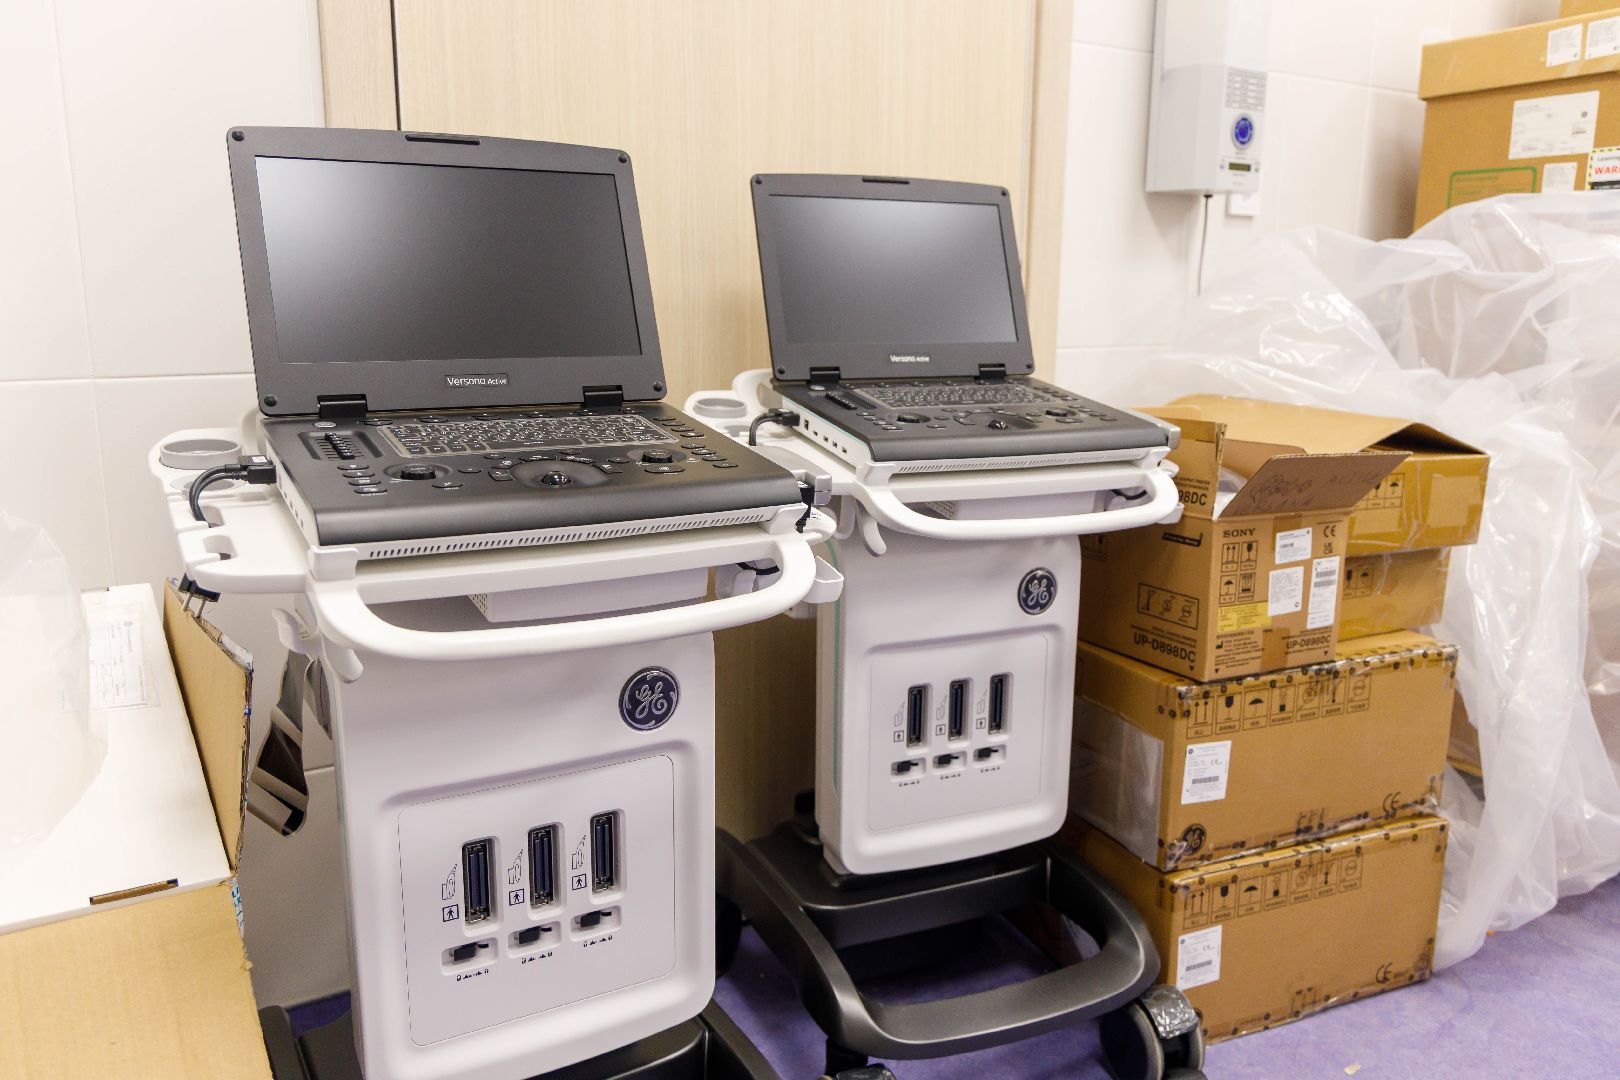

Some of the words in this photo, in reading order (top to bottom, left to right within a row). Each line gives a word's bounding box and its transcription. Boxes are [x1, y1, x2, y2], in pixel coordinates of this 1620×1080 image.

[1595, 165, 1620, 175] WAR
[1222, 528, 1256, 538] SONY
[1133, 632, 1197, 663] UP-D898DC
[1286, 635, 1332, 650] UP-D898DC
